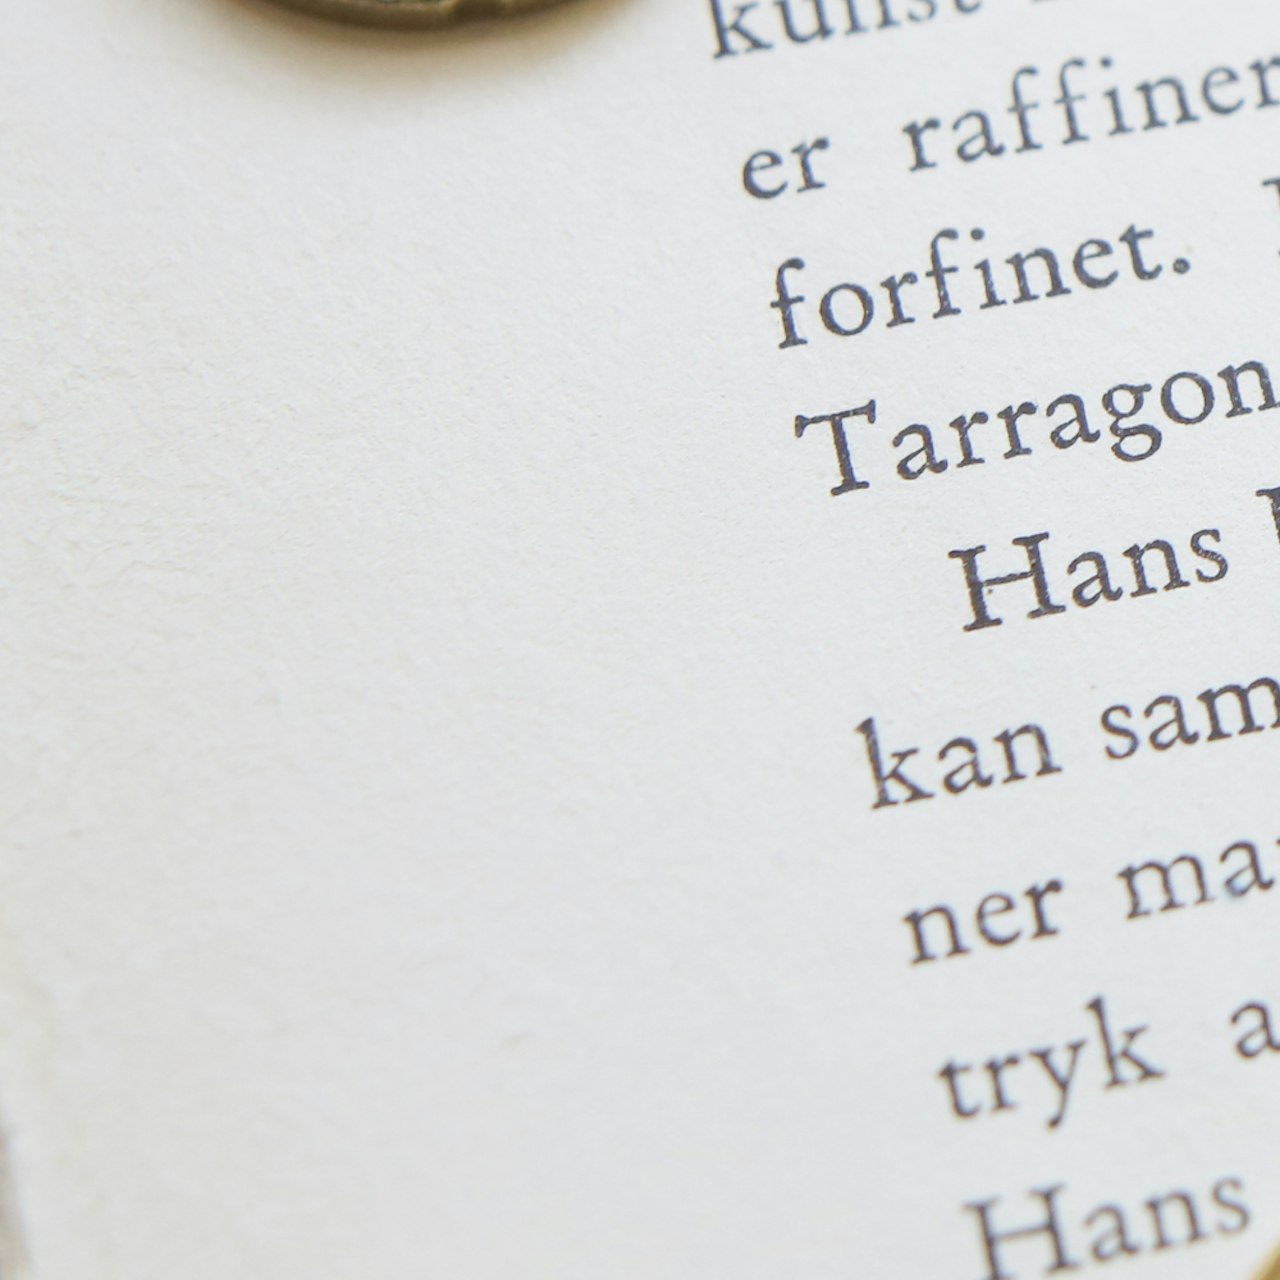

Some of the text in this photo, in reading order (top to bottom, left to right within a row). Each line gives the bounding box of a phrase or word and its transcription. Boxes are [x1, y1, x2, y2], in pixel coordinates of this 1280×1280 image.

[741, 136, 830, 201] er
[770, 225, 1191, 350] forfinet.
[947, 528, 1229, 632] Hans
[855, 717, 1062, 810] kan
[903, 878, 1064, 965] ner
[937, 996, 1165, 1130] tryk
[964, 1177, 1251, 1280] Hans
